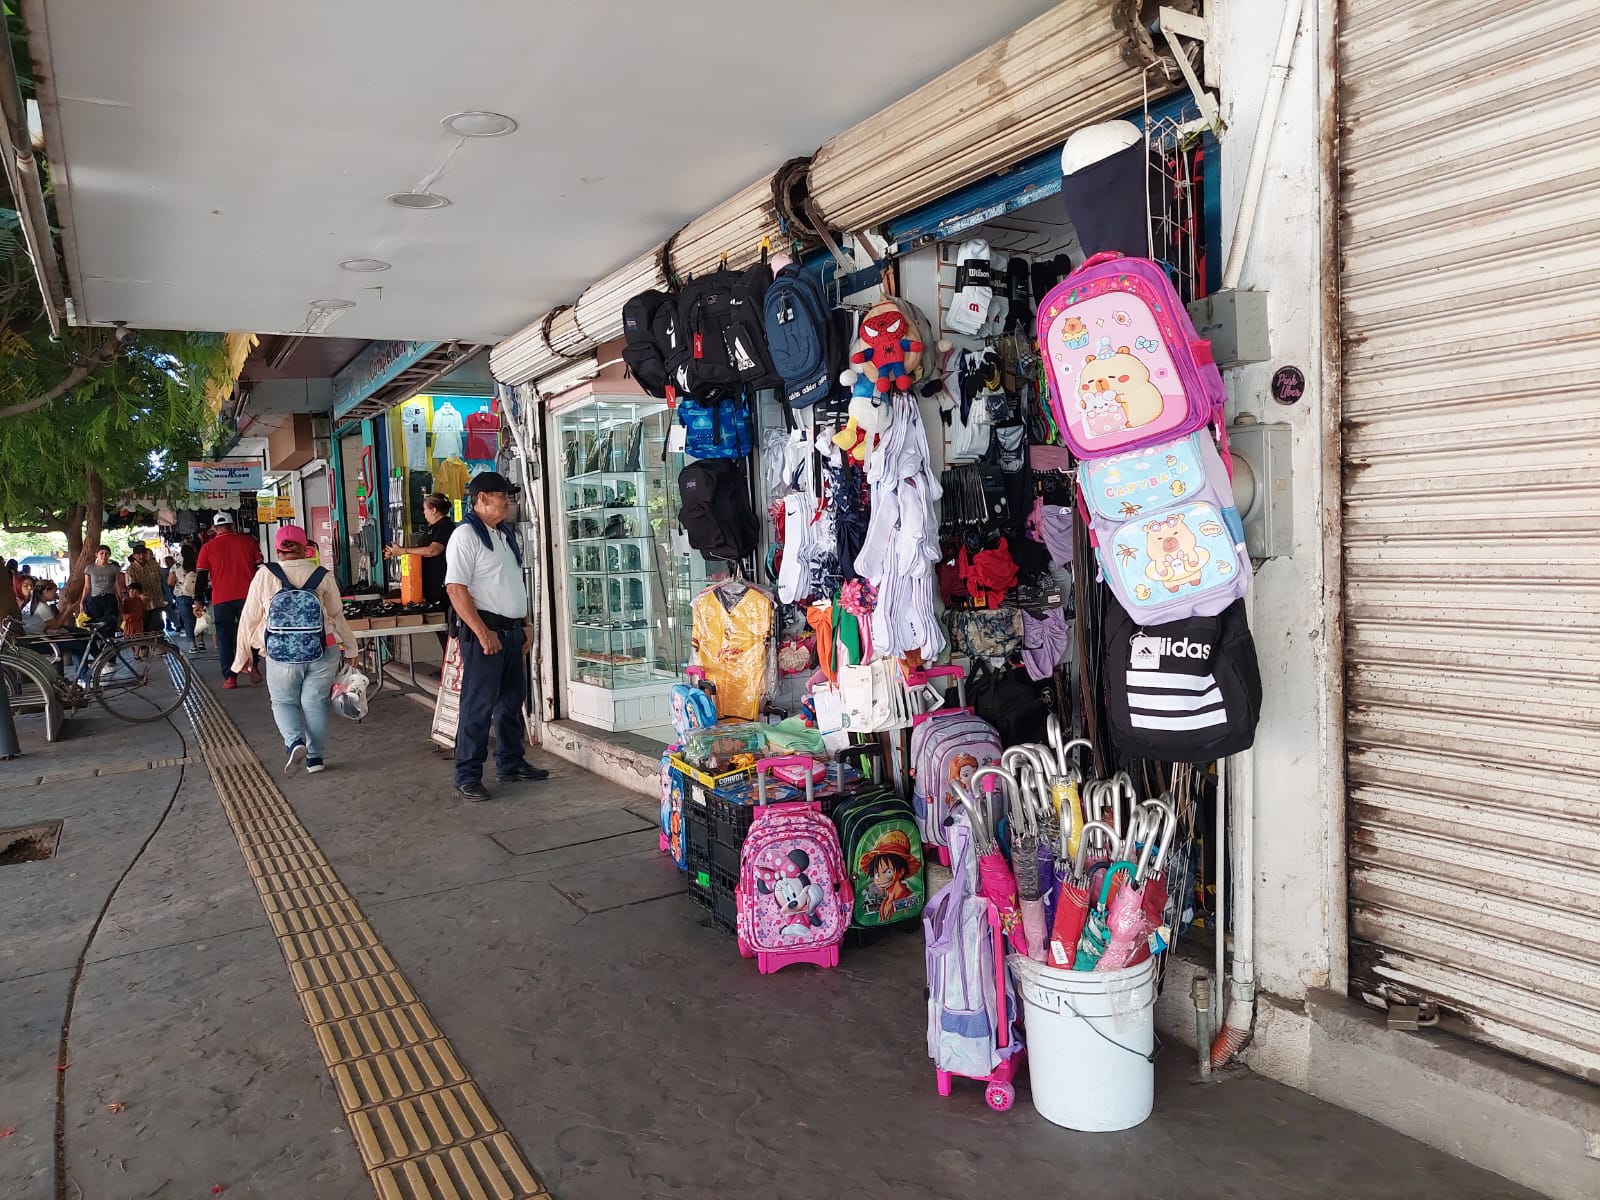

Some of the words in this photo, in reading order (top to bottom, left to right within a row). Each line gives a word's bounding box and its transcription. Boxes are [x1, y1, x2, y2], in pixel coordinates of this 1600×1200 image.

[968, 268, 990, 277] Wilson
[1276, 373, 1297, 387] Pink
[1105, 463, 1188, 498] CAPYBARA
[718, 772, 745, 785] CONVOY
